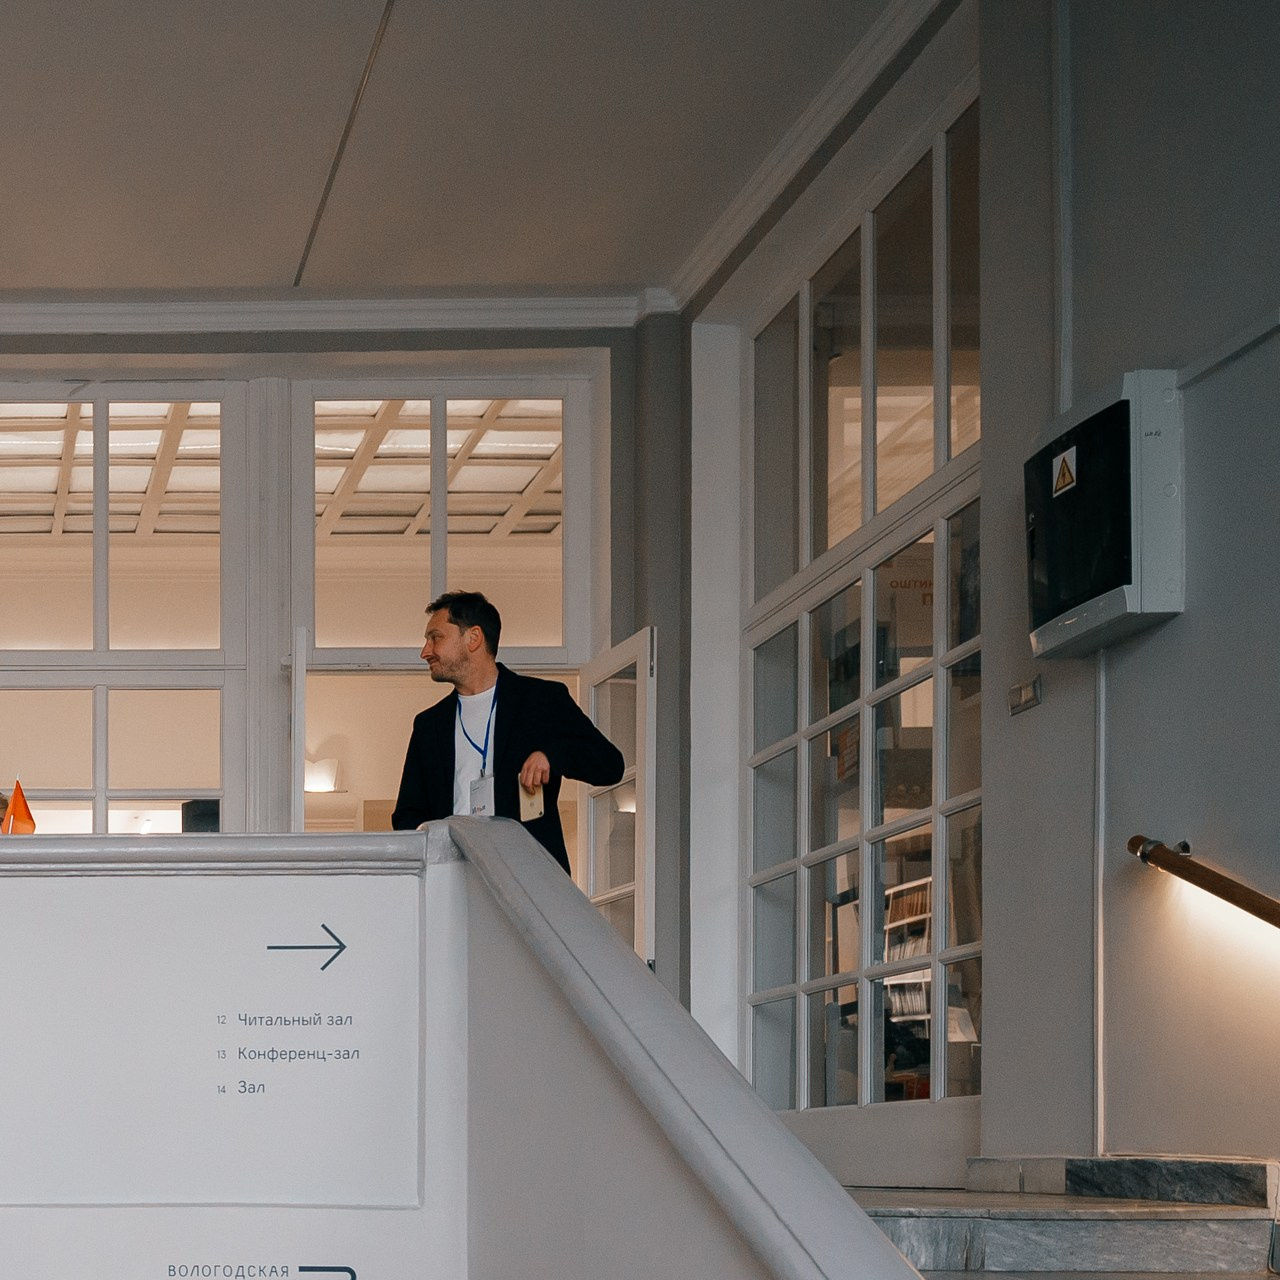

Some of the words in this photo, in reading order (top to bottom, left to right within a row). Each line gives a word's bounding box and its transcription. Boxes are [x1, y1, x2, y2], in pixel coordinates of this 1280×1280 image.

[216, 1014, 227, 1025] 12
[237, 1012, 323, 1027] Читальный
[326, 1015, 353, 1027] зал
[216, 1049, 227, 1060] 13
[237, 1046, 360, 1064] Конференц-зал
[216, 1084, 227, 1095] 14
[237, 1079, 266, 1095] Зал
[167, 1264, 290, 1280] ВОЛОГОДСКАЯ
